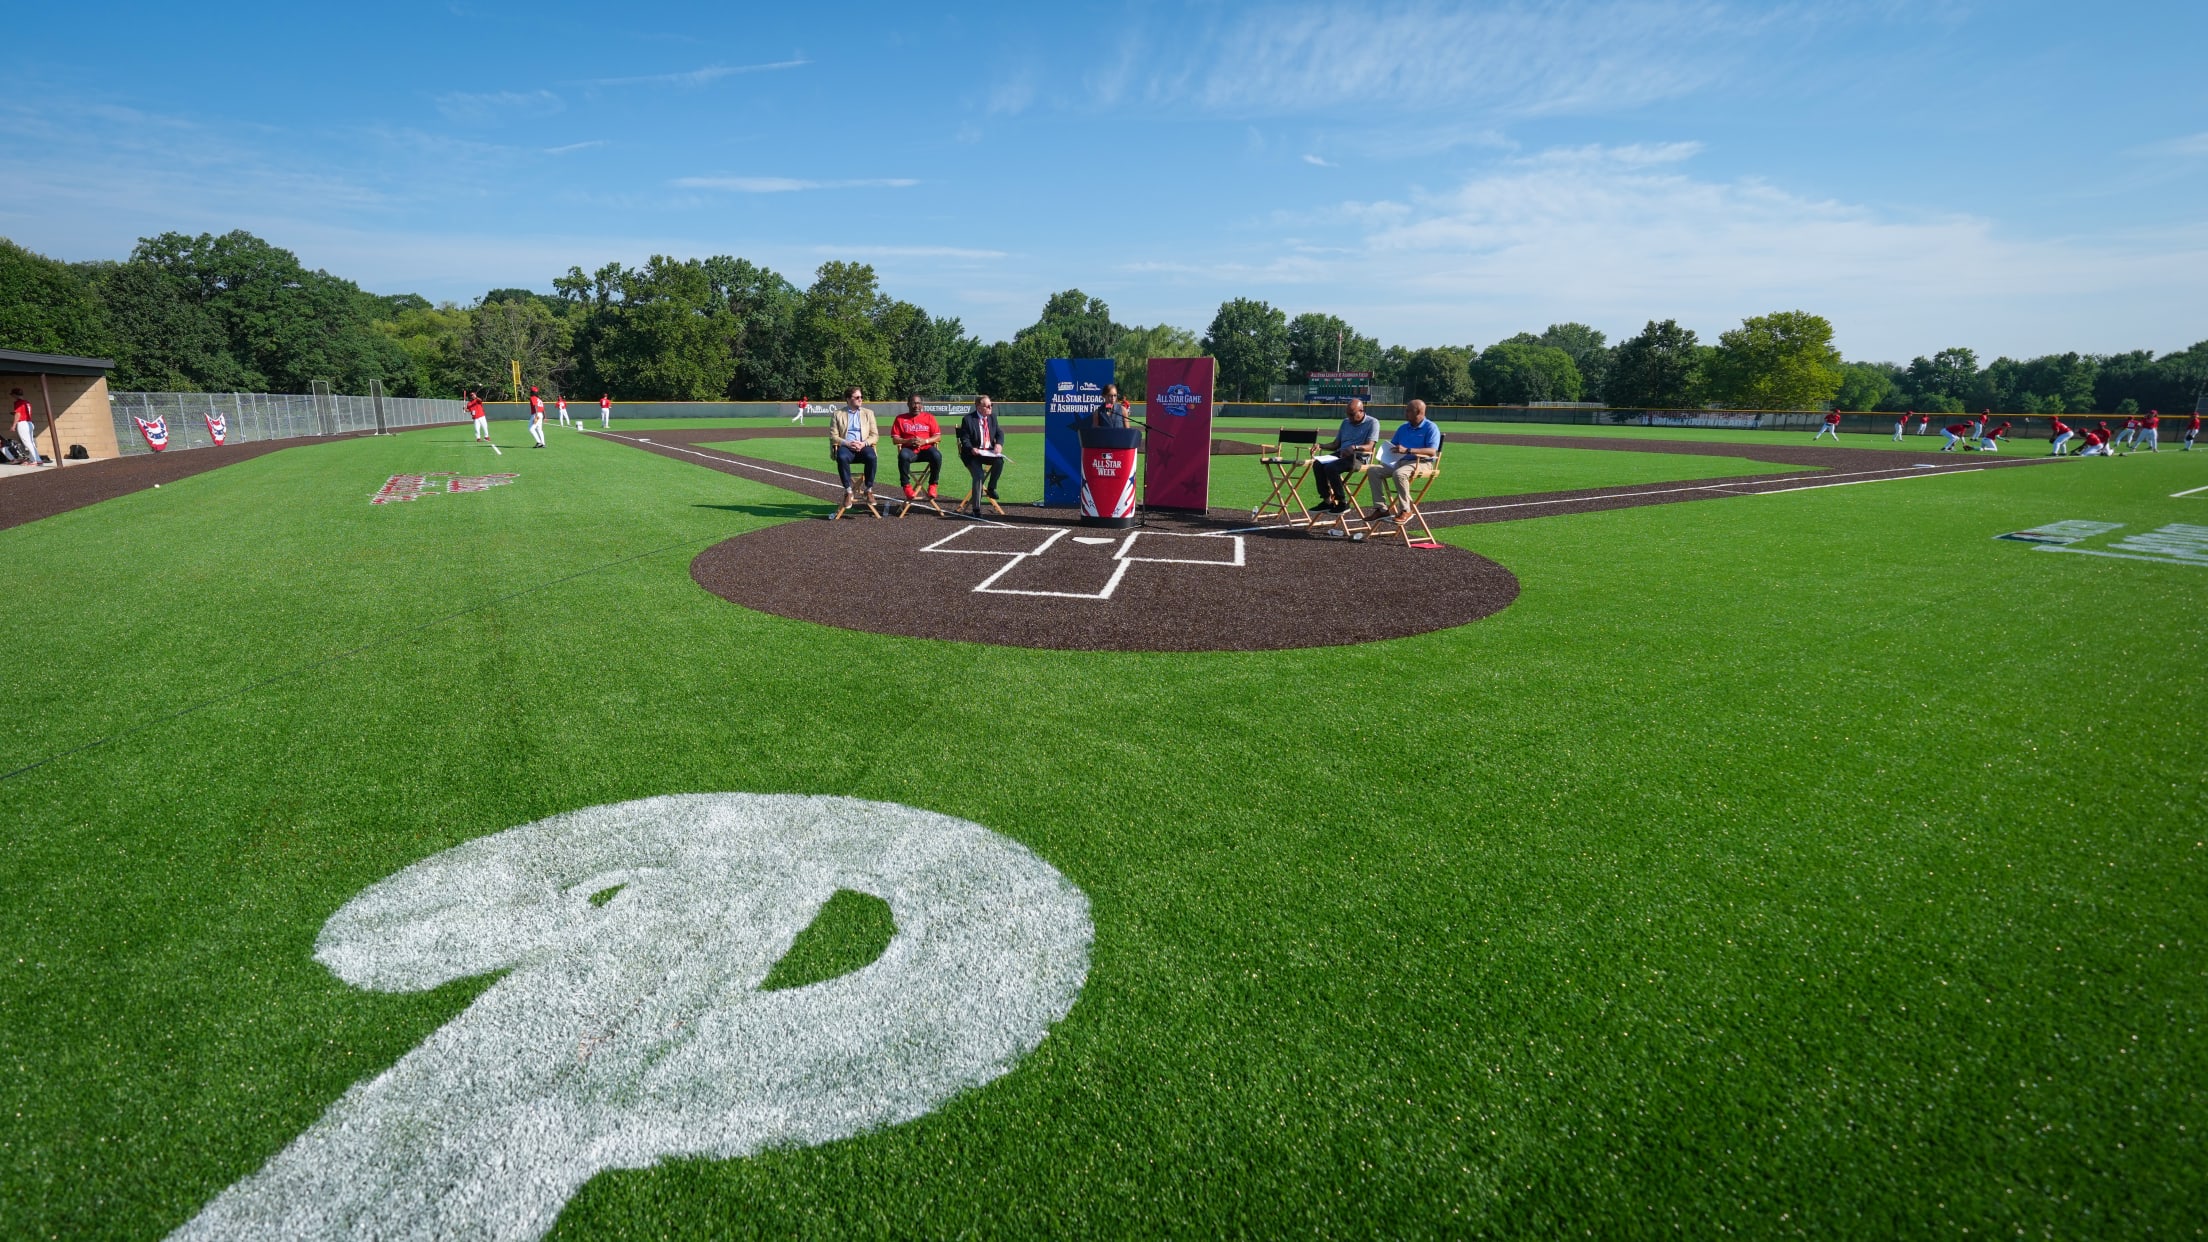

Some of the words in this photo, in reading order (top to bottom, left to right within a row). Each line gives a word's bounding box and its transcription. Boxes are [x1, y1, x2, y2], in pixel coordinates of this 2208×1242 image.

[1052, 393, 1065, 403] ALL
[1065, 393, 1081, 403] STAR
[1156, 393, 1168, 403] ALL
[1168, 394, 1184, 403] STAR
[1184, 394, 1202, 404] GAME
[1057, 403, 1089, 413] ASHBURN
[1092, 459, 1105, 469] ALL
[1105, 459, 1122, 469] STAR
[1097, 468, 1116, 476] WEEK
